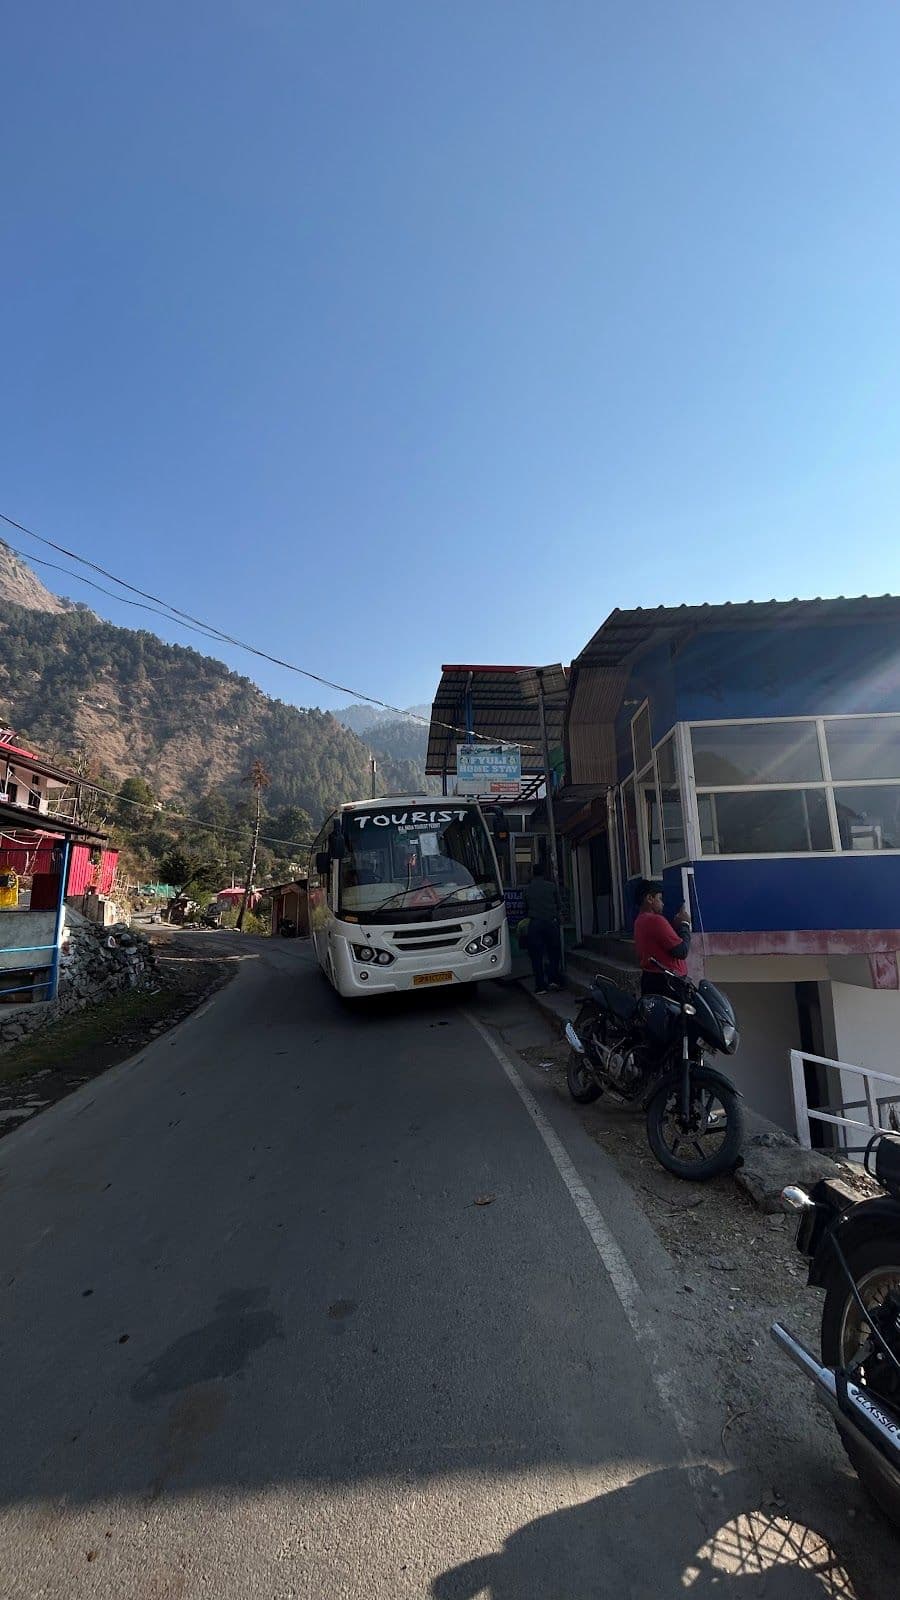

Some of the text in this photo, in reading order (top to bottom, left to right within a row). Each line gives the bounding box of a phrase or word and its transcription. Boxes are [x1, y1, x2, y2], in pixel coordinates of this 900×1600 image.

[459, 764, 518, 773] HOME STAY
[354, 810, 468, 829] TOURIST
[856, 1395, 898, 1433] CLASSIC
